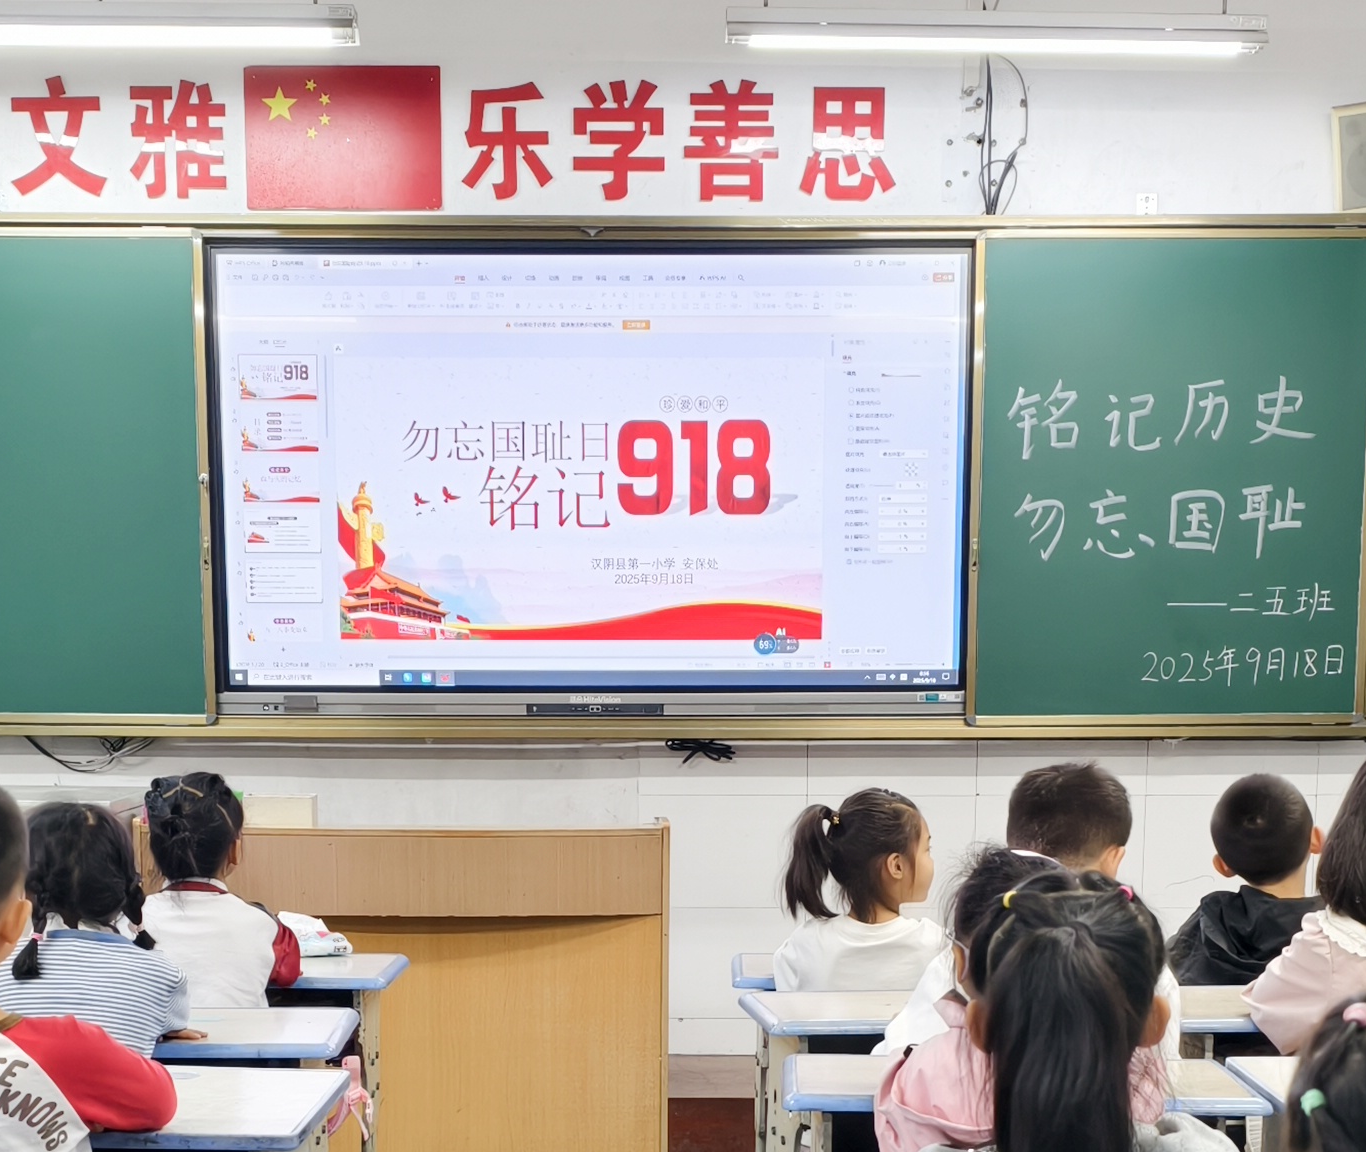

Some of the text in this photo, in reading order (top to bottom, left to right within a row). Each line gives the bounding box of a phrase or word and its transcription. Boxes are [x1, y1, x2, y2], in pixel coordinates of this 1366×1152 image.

[462, 81, 895, 202] 乐学善思
[284, 364, 309, 381] 918
[661, 397, 727, 412] 珍爱和平
[1007, 375, 1317, 460] 铭记历史
[402, 420, 609, 463] 勿忘国耻日
[617, 419, 771, 516] 918
[478, 464, 611, 532] 铭记
[1014, 484, 1306, 562] 勿忘国耻
[591, 557, 719, 571] 汉阴县第一小学 安保处
[614, 573, 694, 585] 2025年9月18日
[1141, 644, 1344, 687] 2025年9月18日
